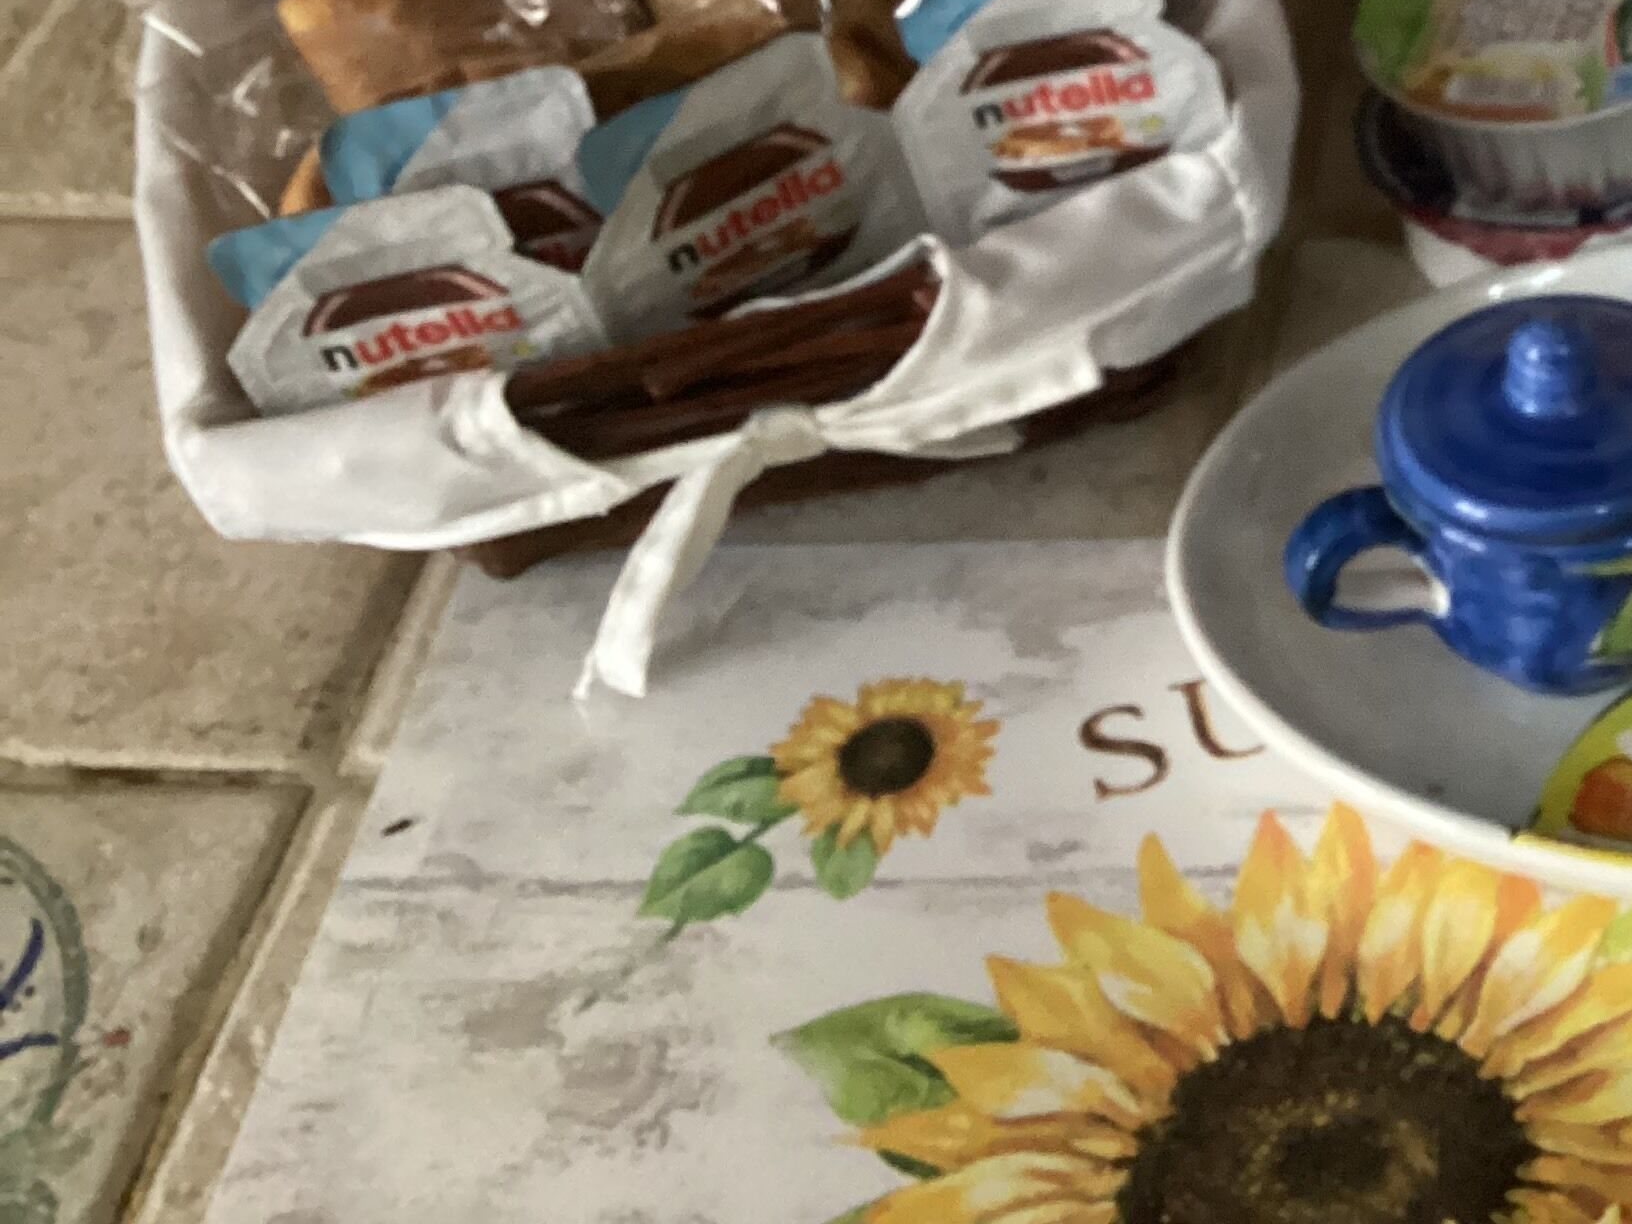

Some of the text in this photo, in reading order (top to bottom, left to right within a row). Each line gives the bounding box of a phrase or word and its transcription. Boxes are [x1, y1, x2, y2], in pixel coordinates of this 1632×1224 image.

[974, 68, 1155, 128] nutella
[668, 159, 845, 273] nutella
[321, 304, 524, 372] nutella
